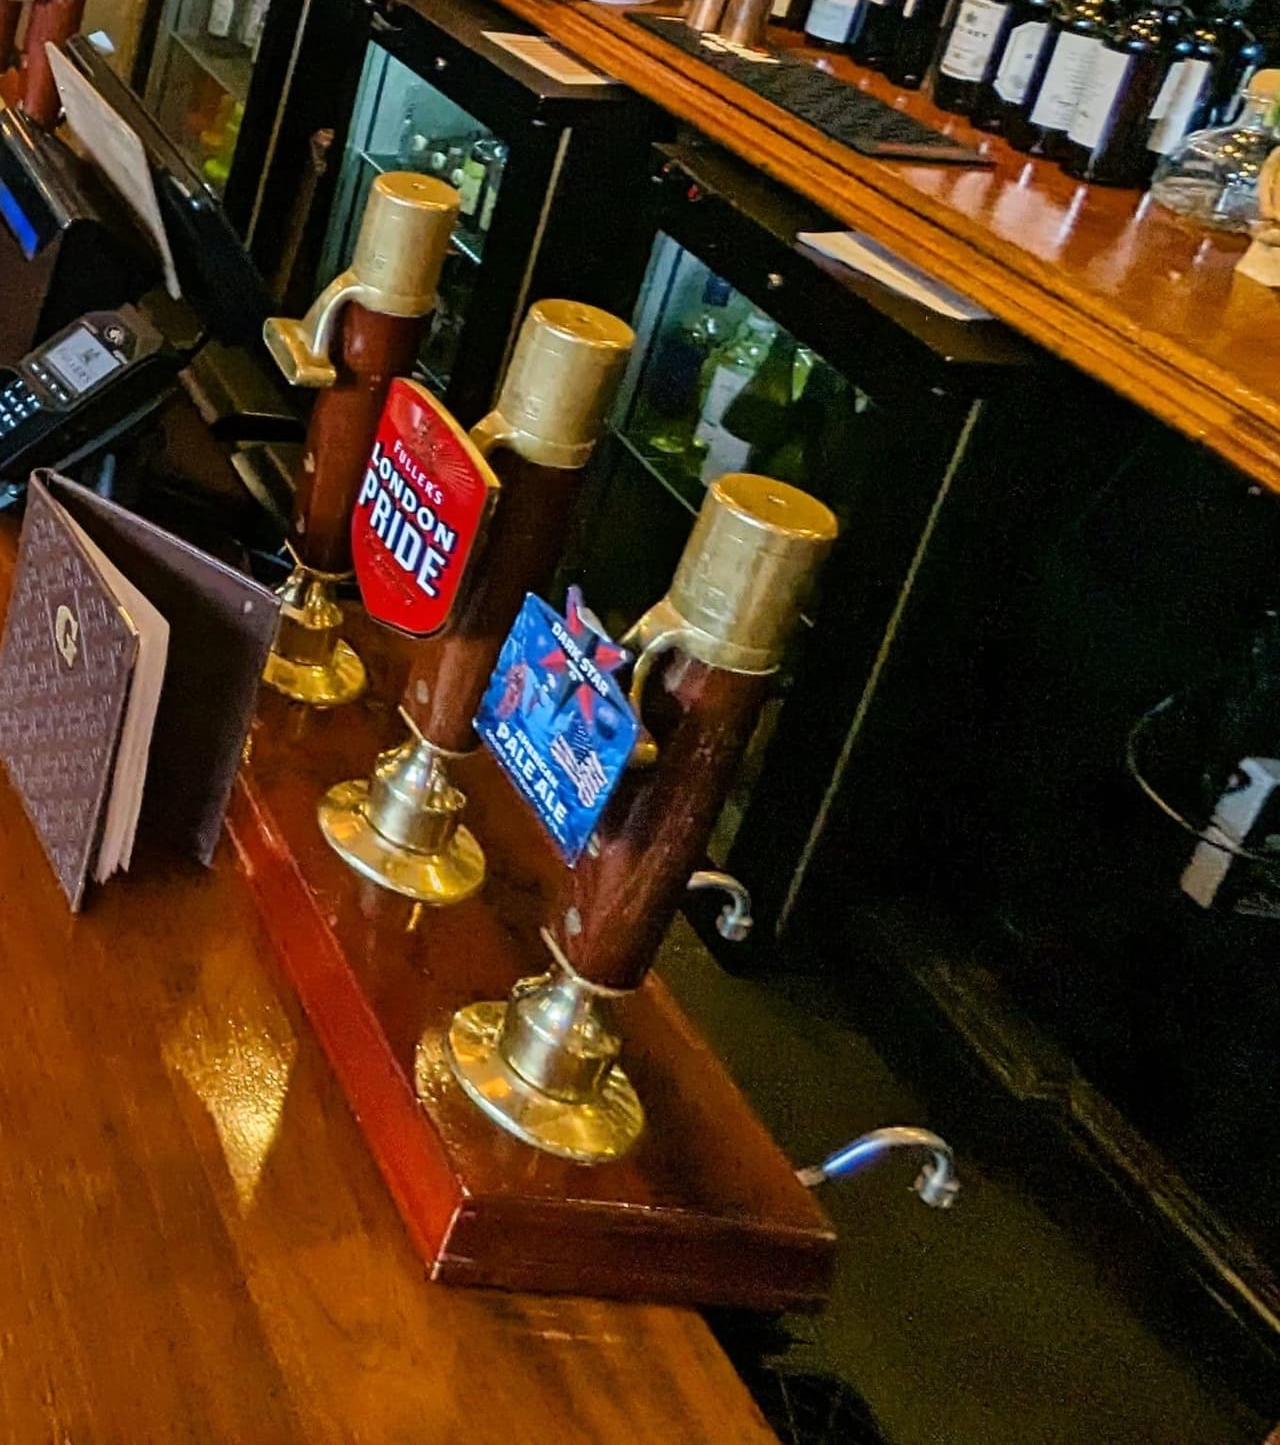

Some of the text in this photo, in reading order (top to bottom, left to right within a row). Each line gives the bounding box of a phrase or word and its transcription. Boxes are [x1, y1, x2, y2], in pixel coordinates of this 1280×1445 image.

[370, 440, 458, 553] LONDON
[392, 438, 444, 506] FULLER'S
[357, 466, 448, 599] PRIDE
[551, 620, 582, 663] DARK
[579, 656, 610, 697] STAR
[495, 721, 537, 781] PALE
[533, 777, 569, 826] ALE
